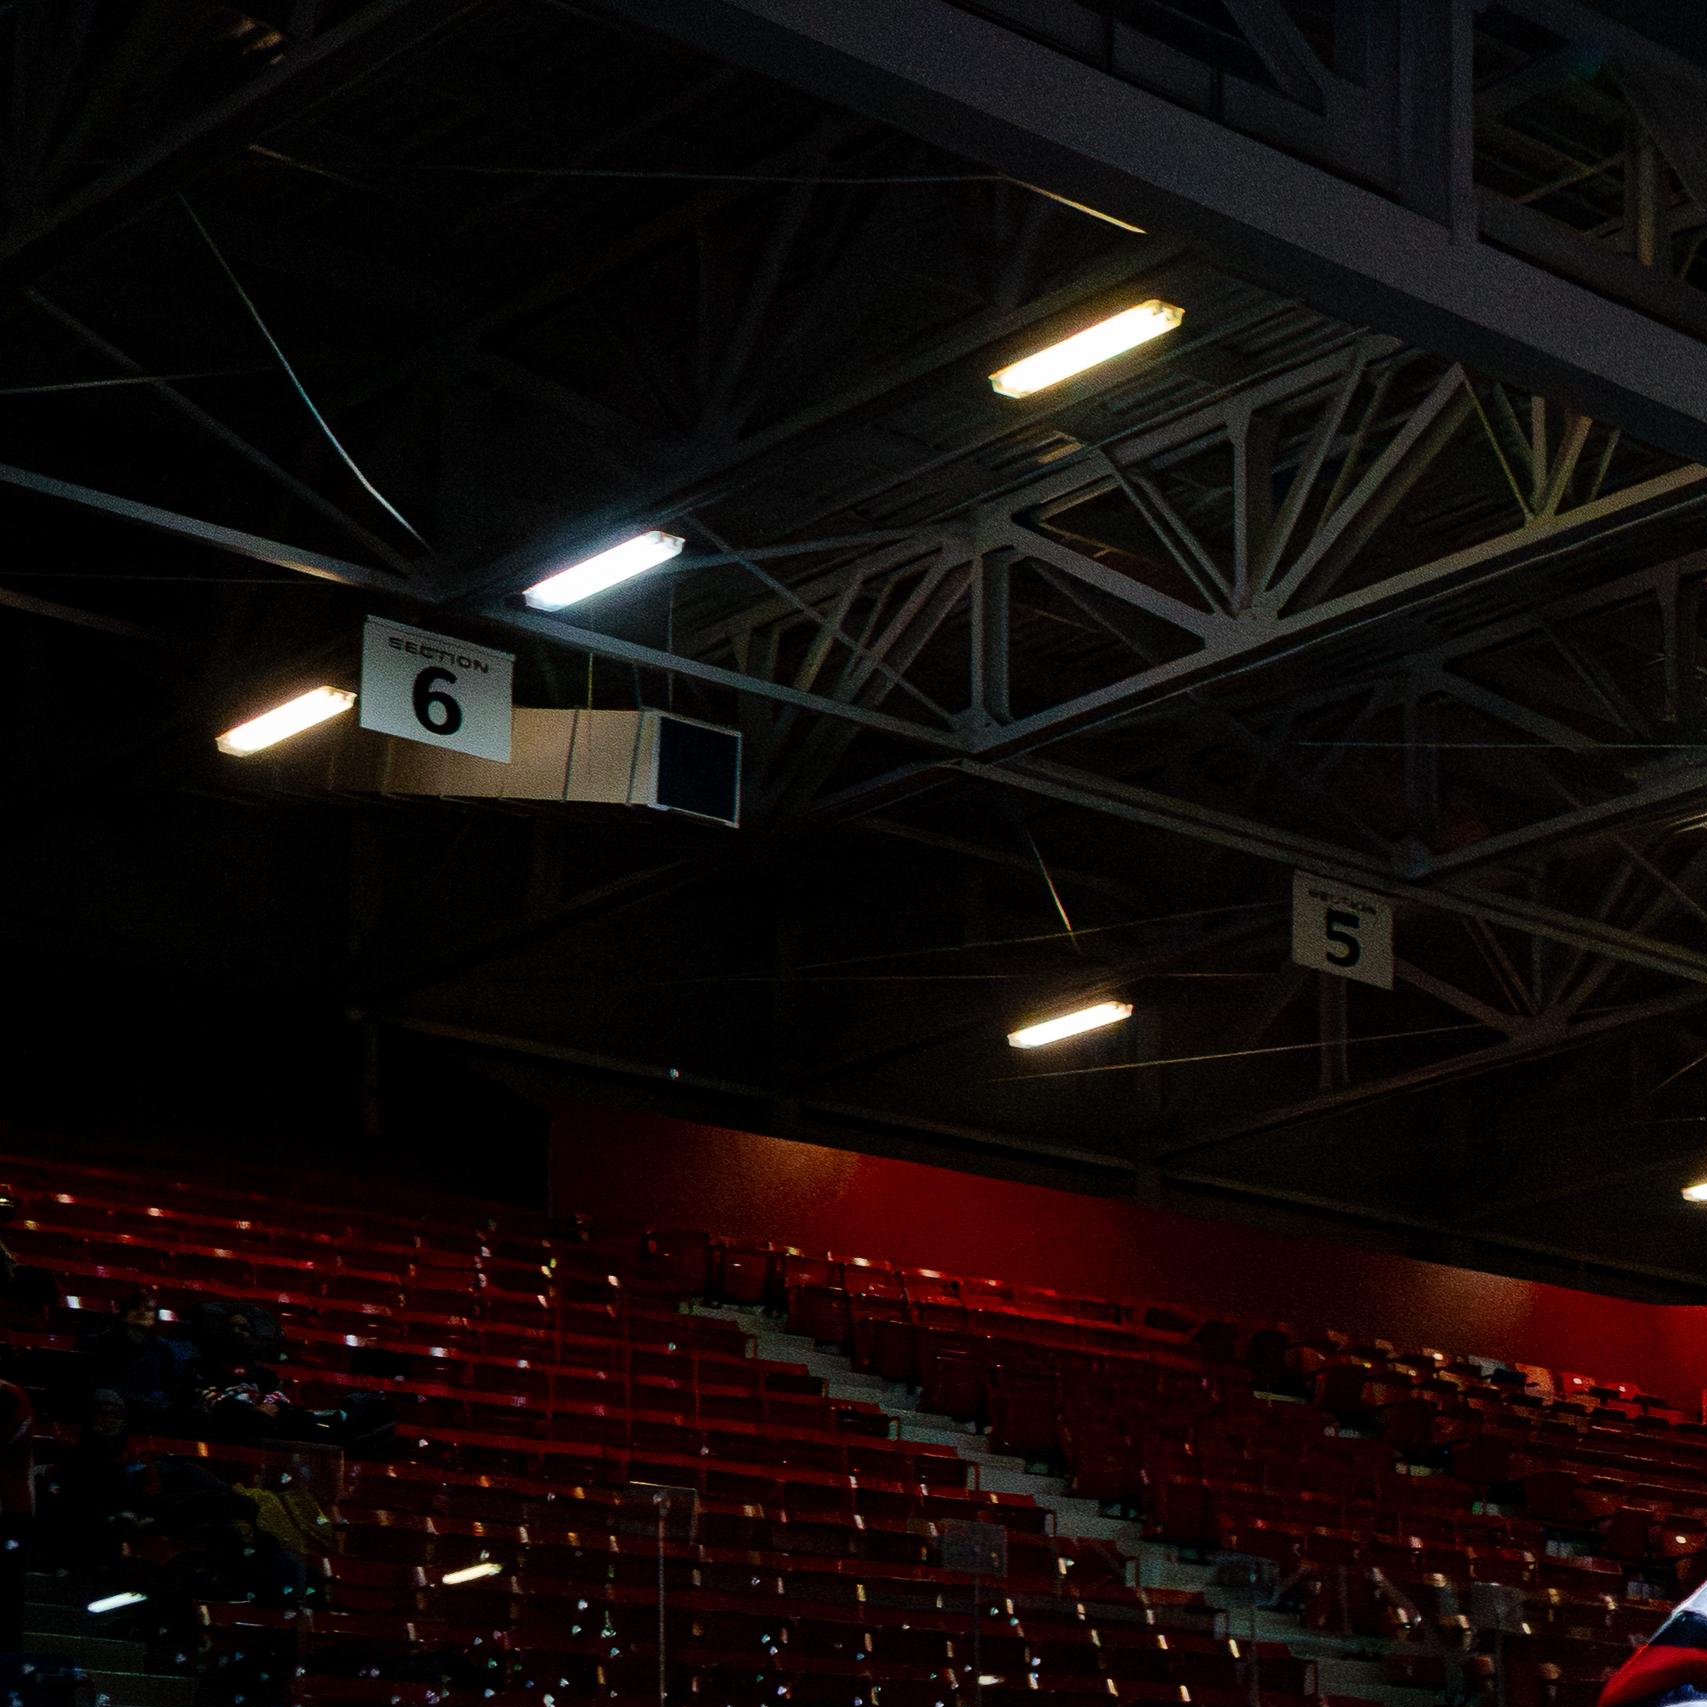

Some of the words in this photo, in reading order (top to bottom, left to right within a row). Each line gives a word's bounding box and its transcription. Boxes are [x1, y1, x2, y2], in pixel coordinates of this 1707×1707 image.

[388, 636, 490, 674] SECTION
[413, 666, 463, 736] 6
[1325, 908, 1360, 968] 5
